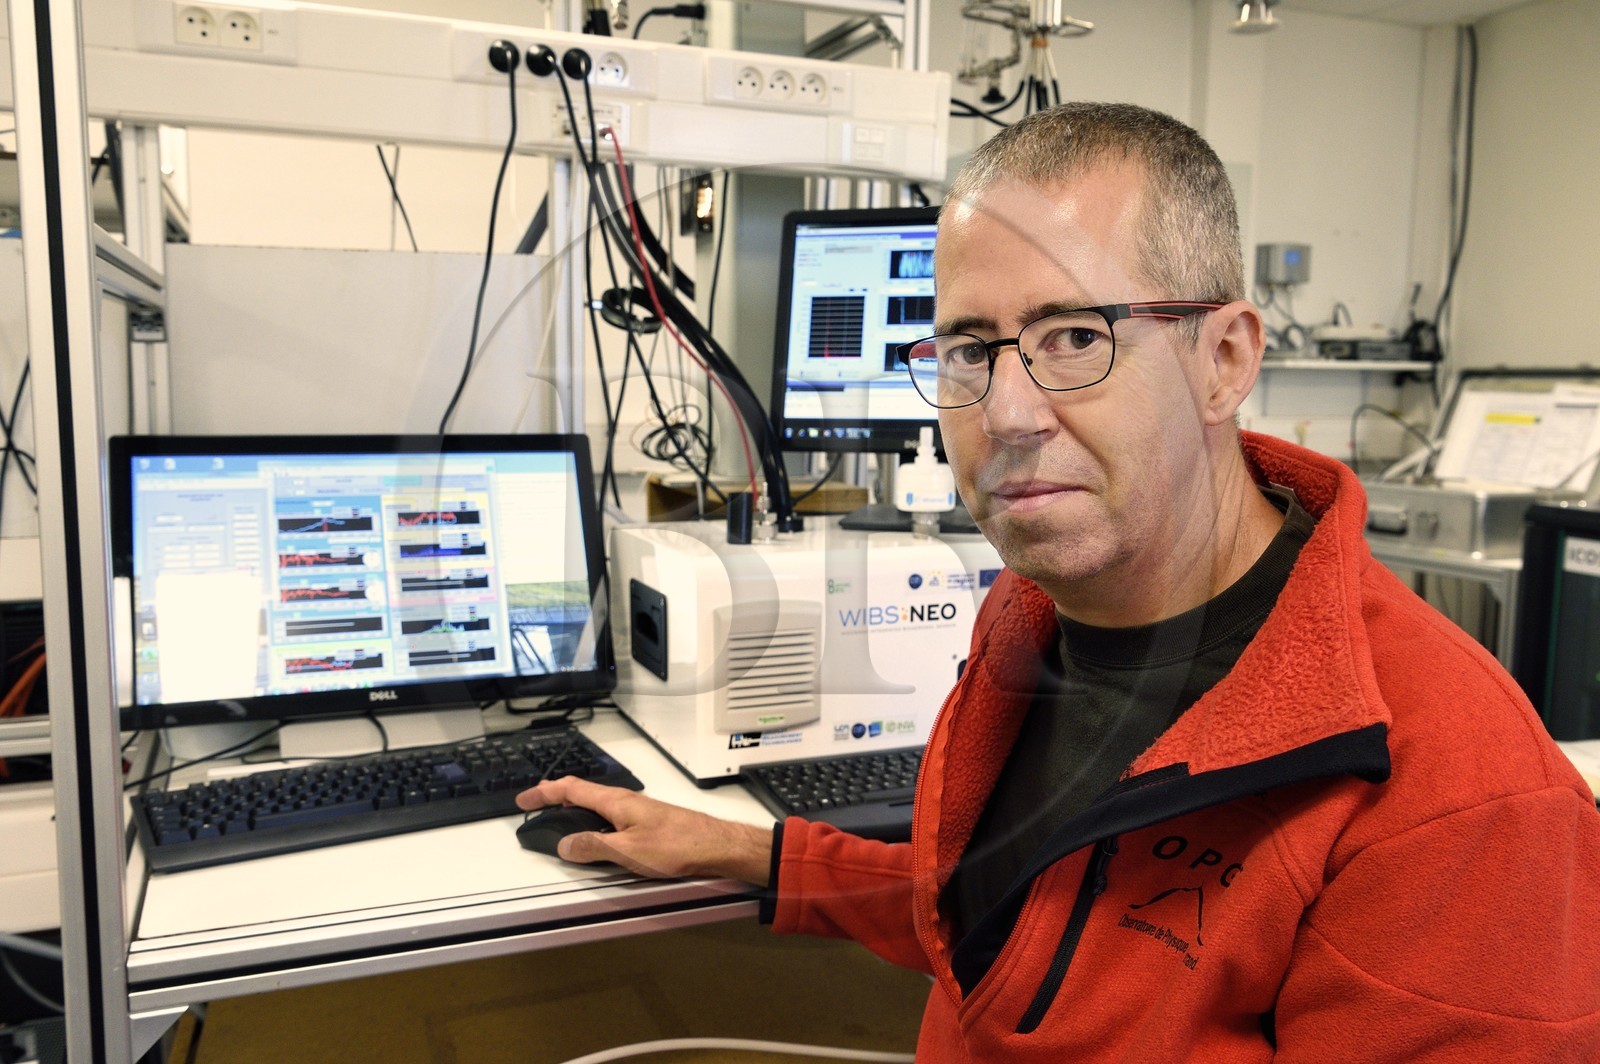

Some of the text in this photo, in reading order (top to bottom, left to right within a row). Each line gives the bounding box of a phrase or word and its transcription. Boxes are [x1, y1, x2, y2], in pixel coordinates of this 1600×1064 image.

[910, 603, 956, 623] NEO
[369, 690, 398, 701] DELL
[1118, 913, 1157, 936] Observatoire
[1154, 925, 1165, 940] de
[1162, 929, 1189, 953] Physique
